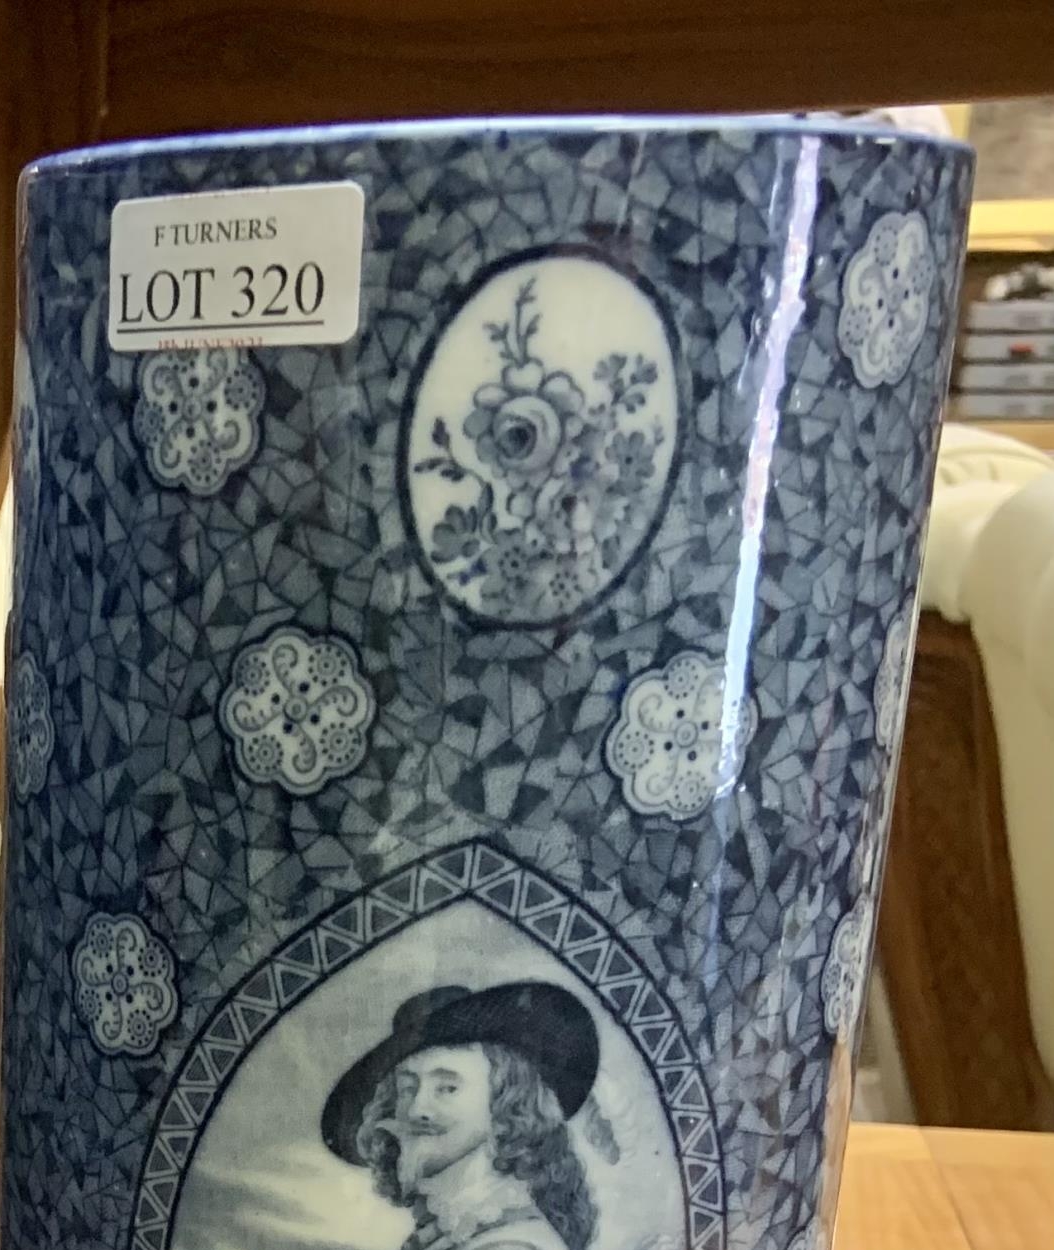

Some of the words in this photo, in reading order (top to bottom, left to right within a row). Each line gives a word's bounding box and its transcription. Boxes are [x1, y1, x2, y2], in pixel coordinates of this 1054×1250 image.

[154, 225, 166, 247] F
[170, 217, 278, 246] TURNERS
[119, 268, 216, 323] LOT
[231, 261, 325, 318] 320
